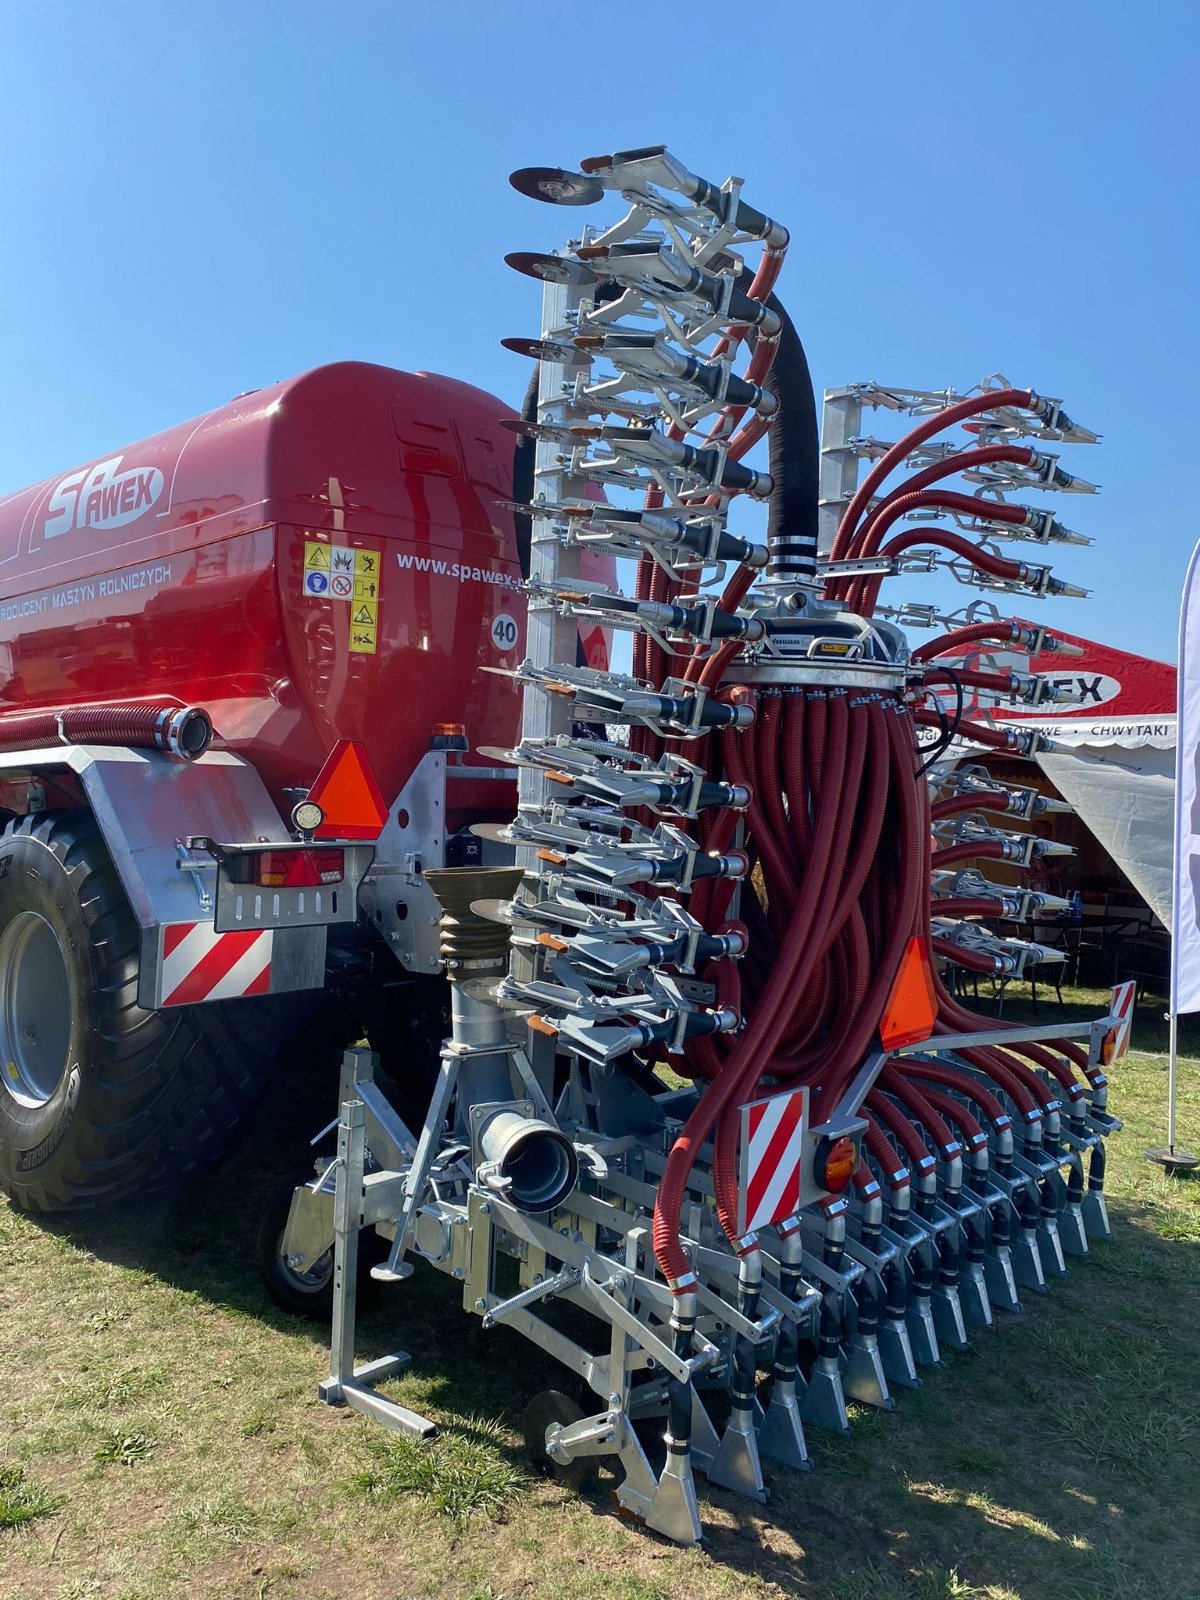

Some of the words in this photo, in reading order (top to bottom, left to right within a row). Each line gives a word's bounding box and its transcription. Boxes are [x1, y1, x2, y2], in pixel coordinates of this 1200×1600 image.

[0, 597, 48, 622] RODUCENT
[52, 584, 95, 610] MASZYN
[100, 564, 171, 598] ROLNICZYCH
[493, 620, 516, 643] 40
[1091, 725, 1168, 736] CHWYTAKI
